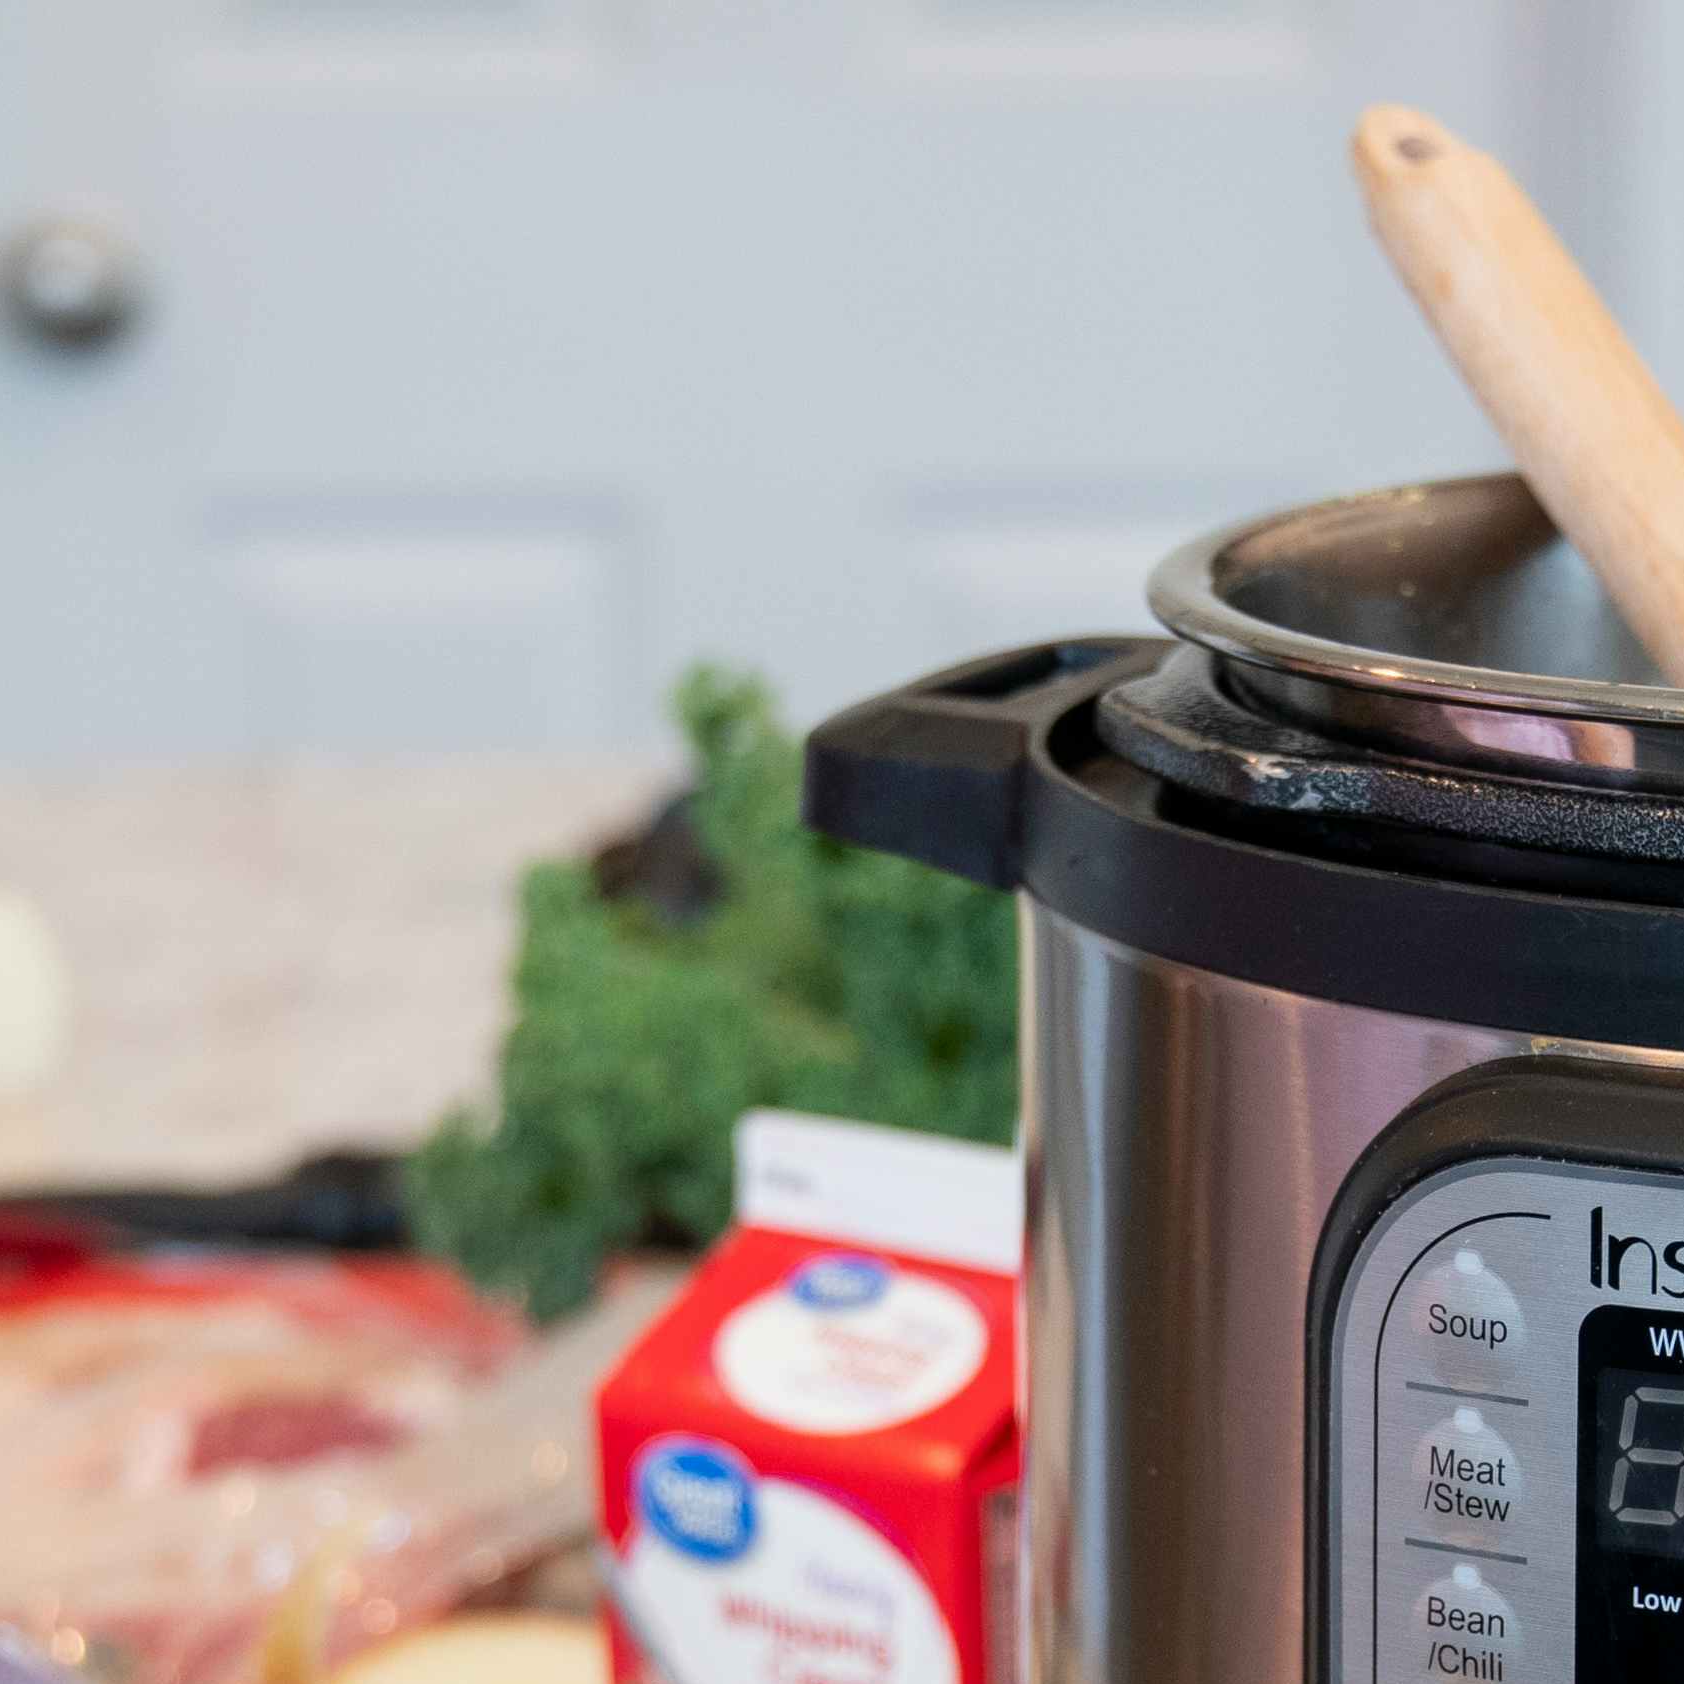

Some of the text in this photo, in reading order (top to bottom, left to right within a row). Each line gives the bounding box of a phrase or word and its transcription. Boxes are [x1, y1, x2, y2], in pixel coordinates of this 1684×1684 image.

[1429, 1304, 1507, 1349] Soup
[1429, 1446, 1505, 1487] Meat
[1424, 1479, 1510, 1522] /Stew
[1428, 1596, 1504, 1638] Bean
[1633, 1589, 1683, 1616] Low
[1428, 1642, 1502, 1682] /Chili
